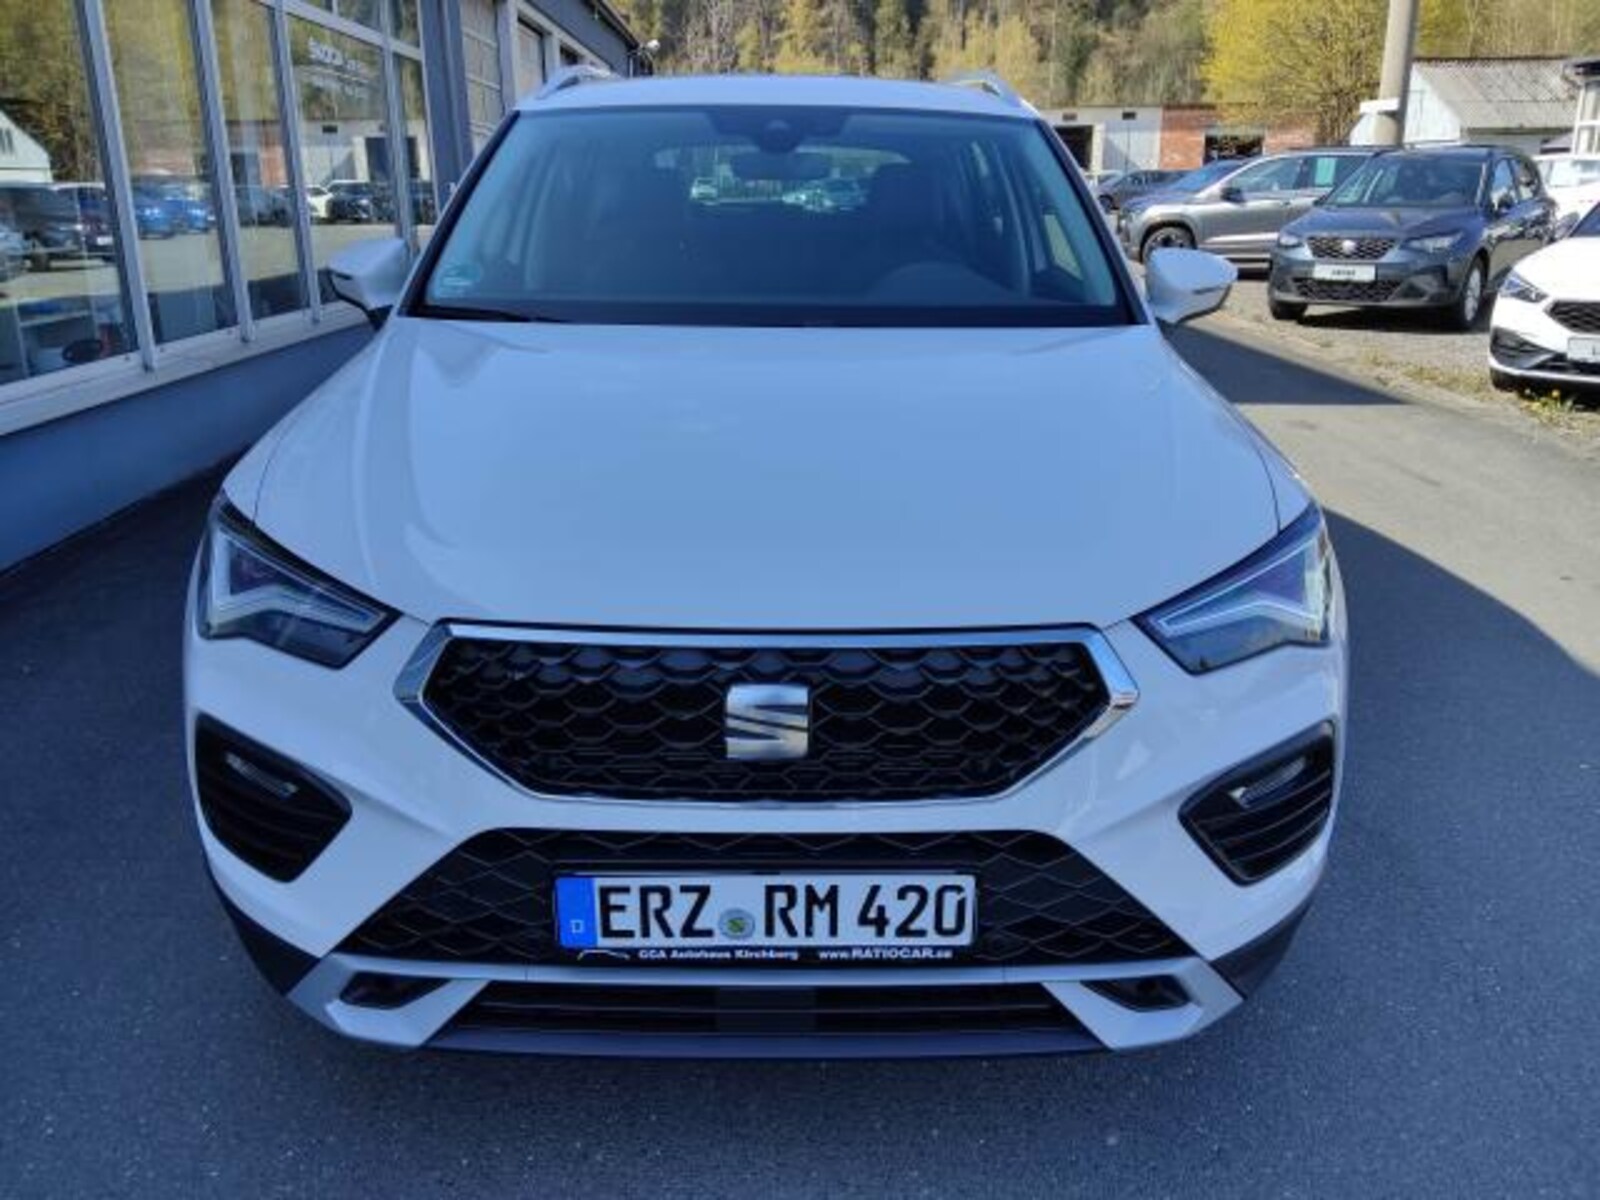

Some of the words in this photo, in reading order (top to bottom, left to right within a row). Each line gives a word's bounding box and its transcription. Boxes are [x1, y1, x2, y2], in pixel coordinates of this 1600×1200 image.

[570, 919, 585, 934] D
[599, 885, 714, 939] ERZ
[764, 884, 839, 938] RM
[857, 884, 967, 938] 420
